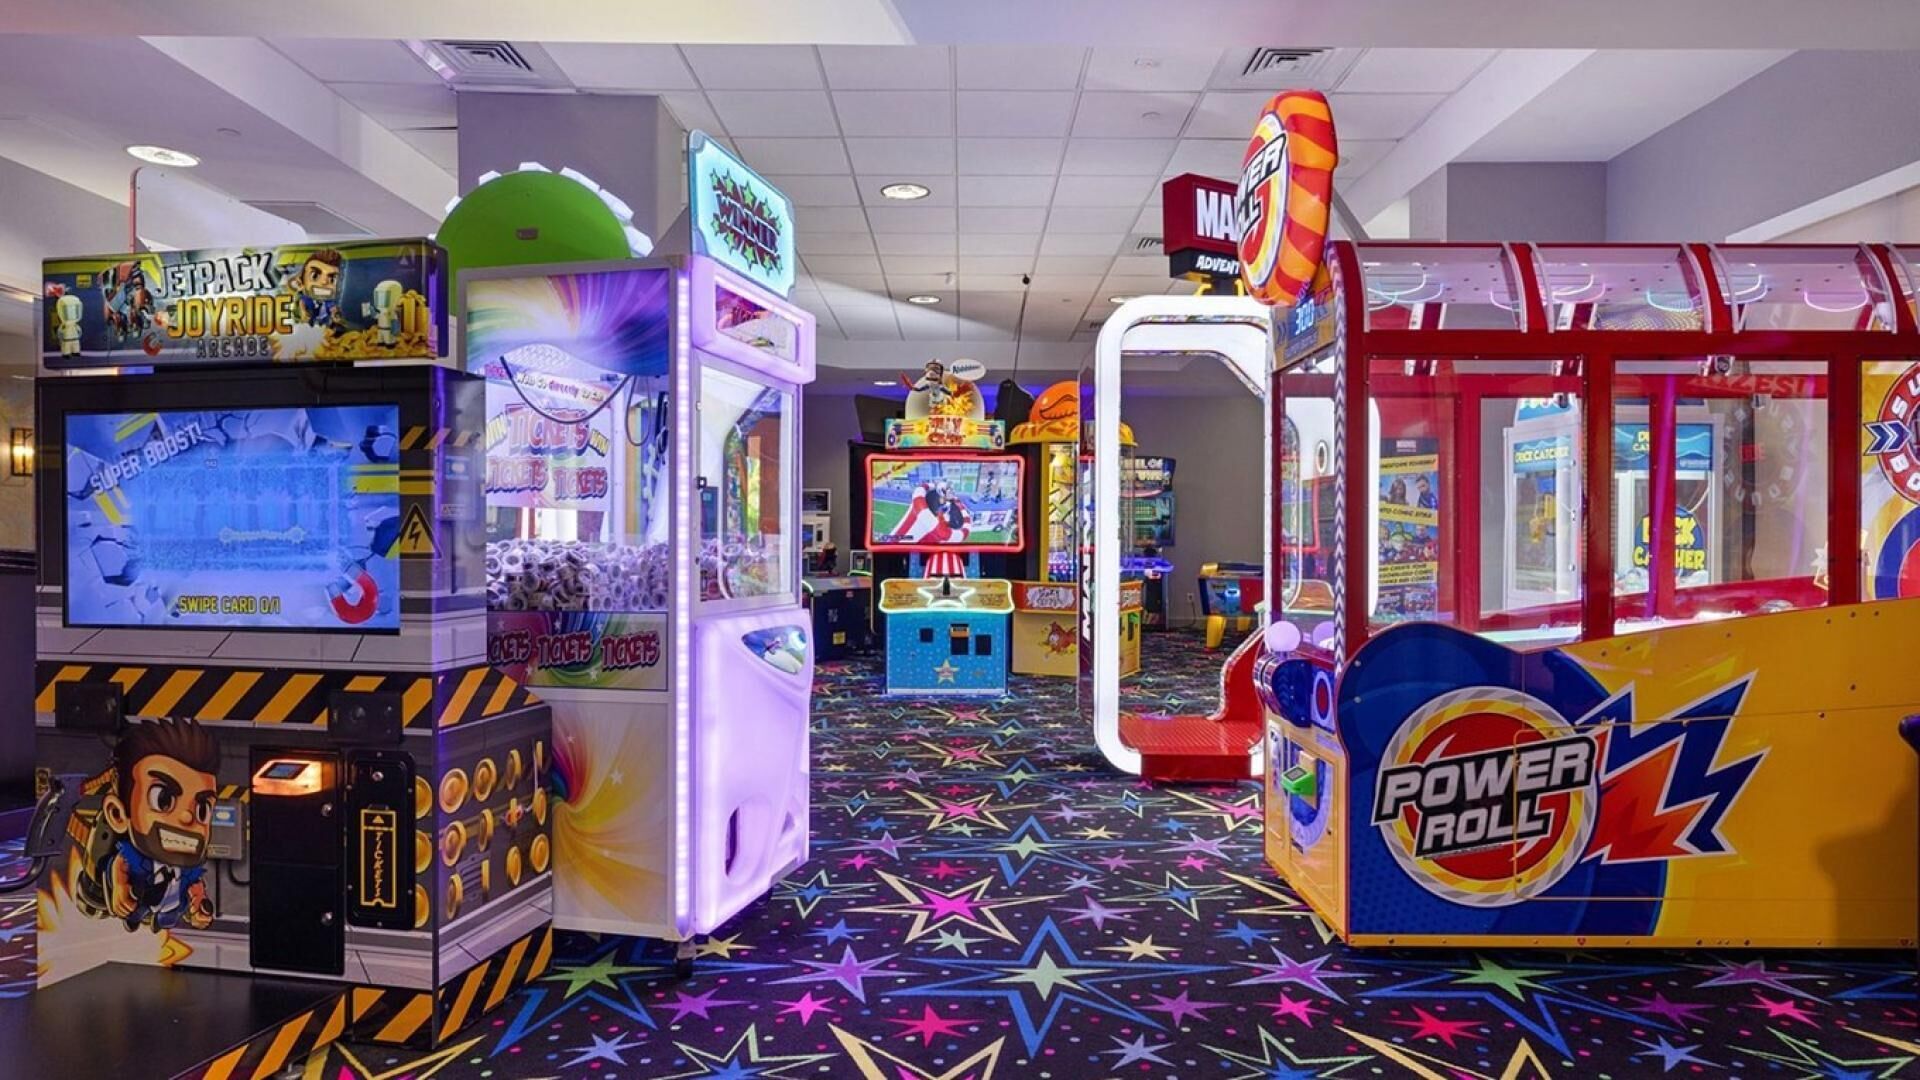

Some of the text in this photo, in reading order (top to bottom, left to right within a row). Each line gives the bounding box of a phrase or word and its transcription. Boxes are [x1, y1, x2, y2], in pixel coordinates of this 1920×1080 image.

[155, 252, 276, 299] JETPACK
[167, 295, 293, 338] JOYRIDE
[196, 336, 269, 359] ARCADE
[90, 421, 203, 494] SUPER BOOST!
[179, 596, 218, 614] SWIPE
[221, 596, 257, 614] CARD
[537, 631, 593, 669] TICKETS
[602, 631, 660, 672] TICKETS
[1380, 741, 1592, 817] POWER
[1422, 799, 1546, 850] ROLL
[372, 831, 384, 898] TICKETS
